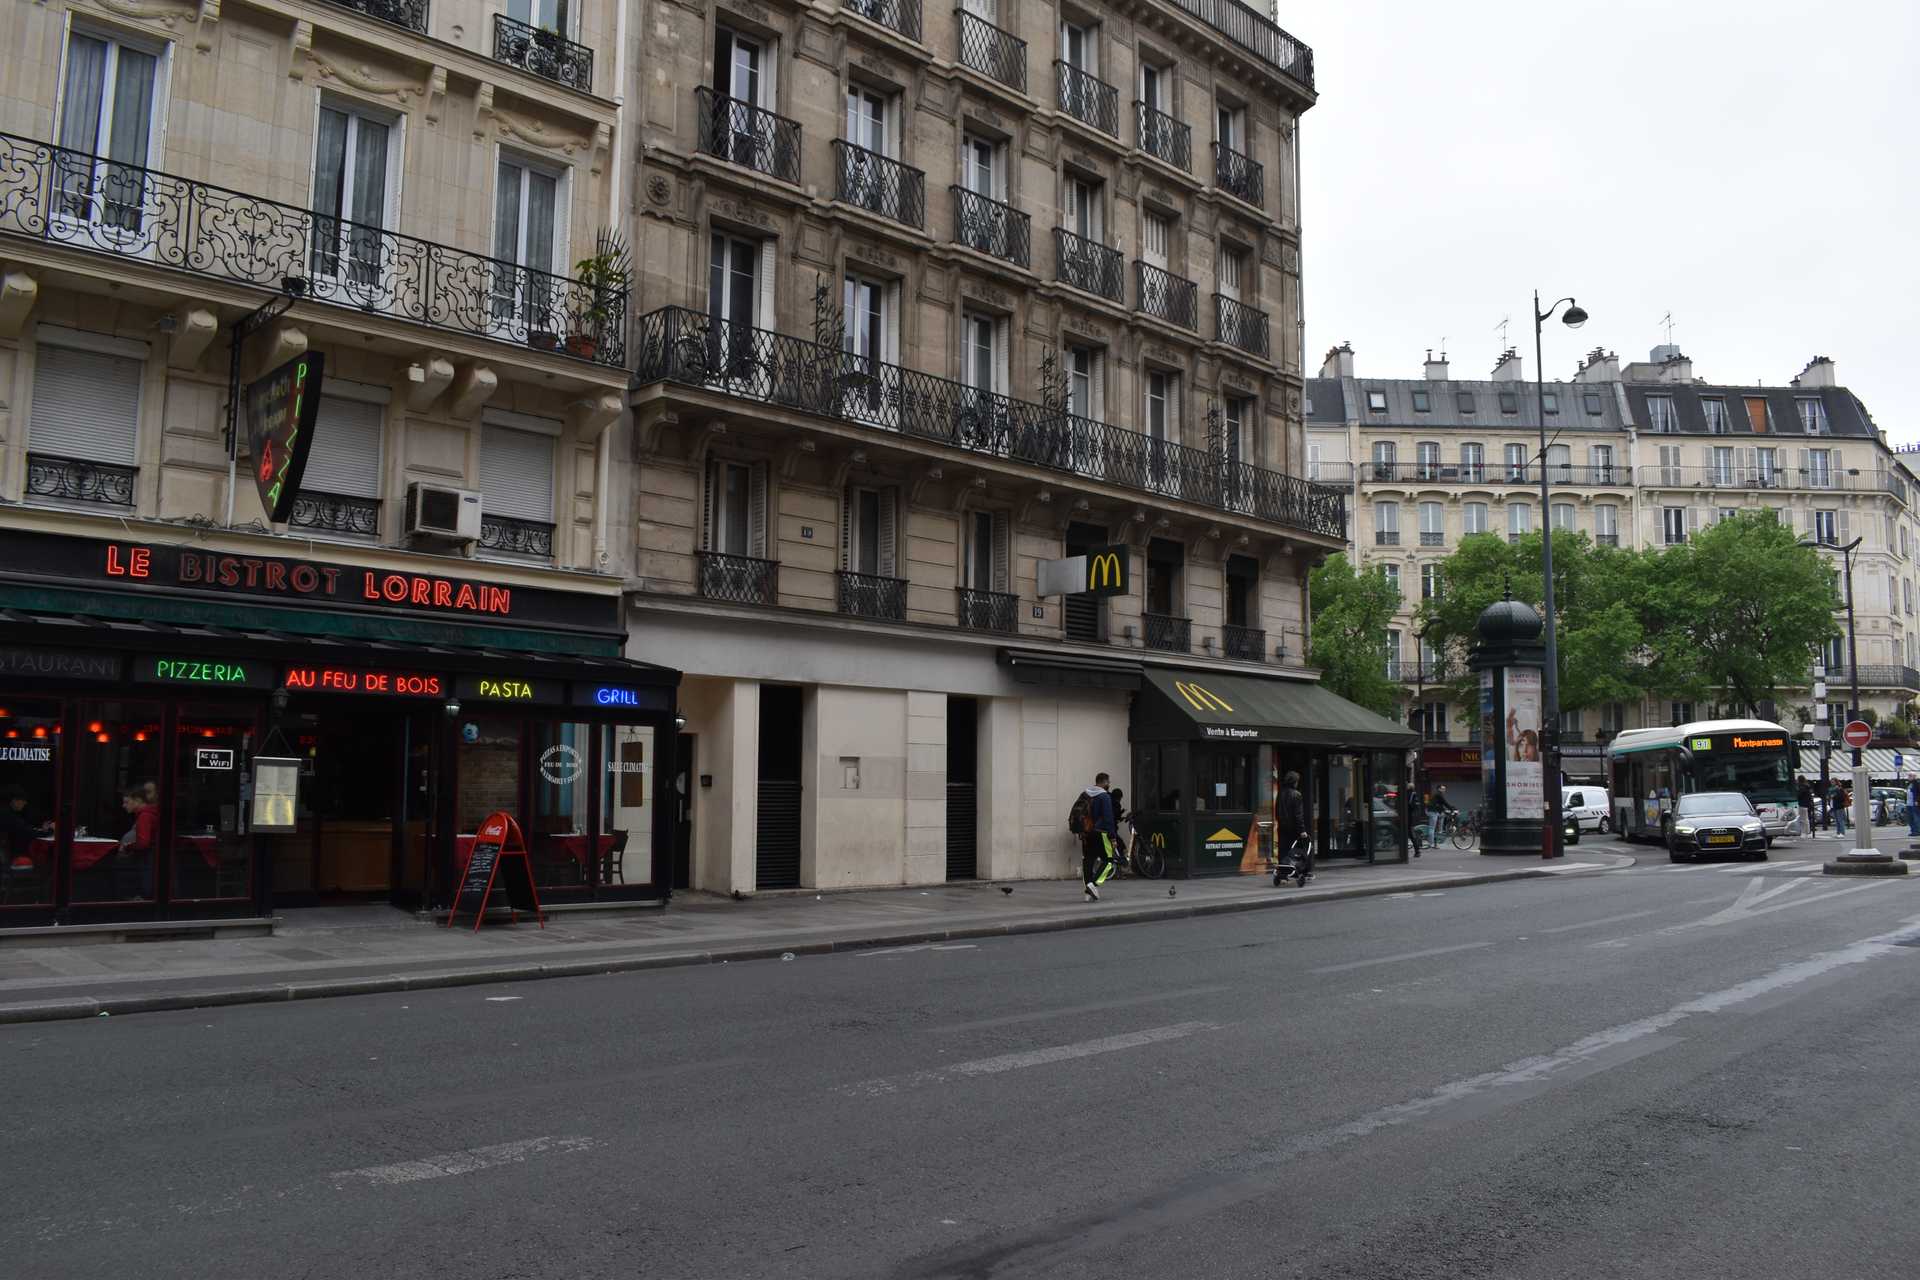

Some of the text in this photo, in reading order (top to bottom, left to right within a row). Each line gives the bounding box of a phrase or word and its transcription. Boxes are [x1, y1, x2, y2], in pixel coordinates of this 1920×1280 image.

[268, 362, 307, 508] PIZZA
[106, 544, 512, 614] LE BISTROT LORRAIN
[155, 659, 247, 684] PIZZERIA
[286, 668, 441, 696] AU FEU DE BOIS
[480, 680, 533, 699] PASTA
[597, 688, 639, 706] GRILL
[1206, 727, 1224, 736] Vente
[1230, 728, 1258, 738] Emporter
[1696, 740, 1708, 748] 91
